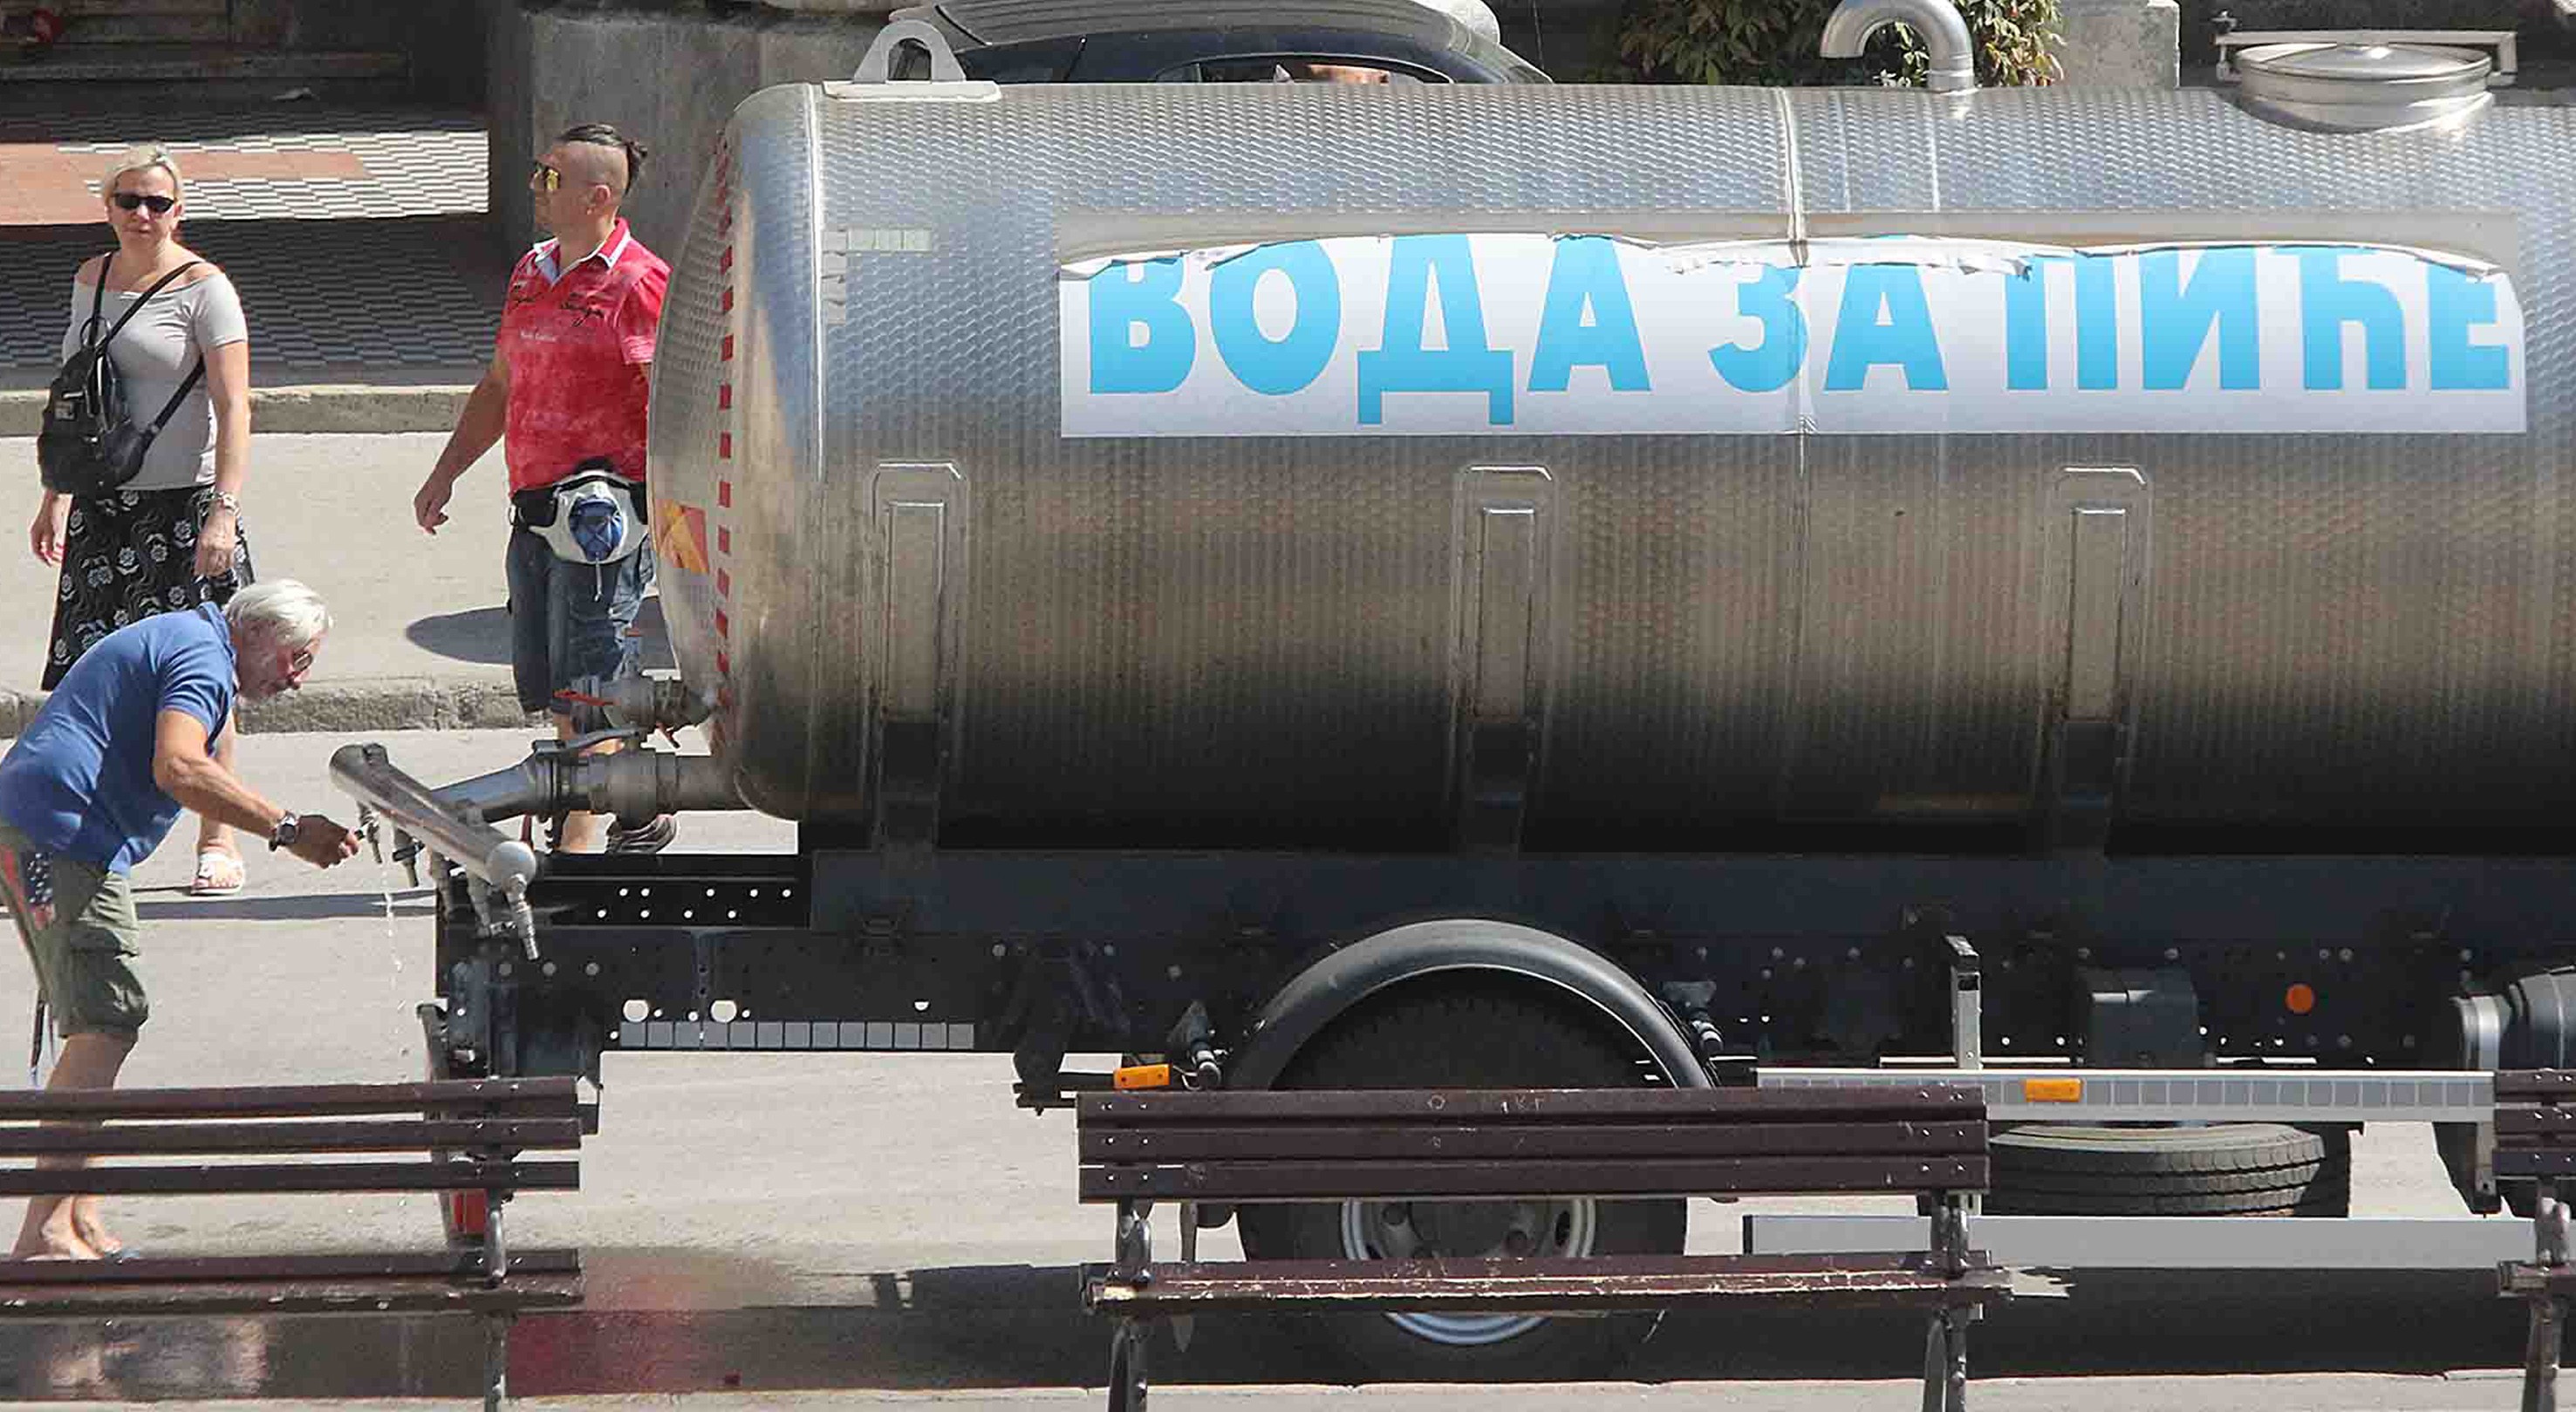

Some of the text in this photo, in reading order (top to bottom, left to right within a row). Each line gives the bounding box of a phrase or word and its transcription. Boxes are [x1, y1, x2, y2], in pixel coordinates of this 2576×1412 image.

[1090, 234, 2510, 425] ВОДА ЗА ПИЋЕ
